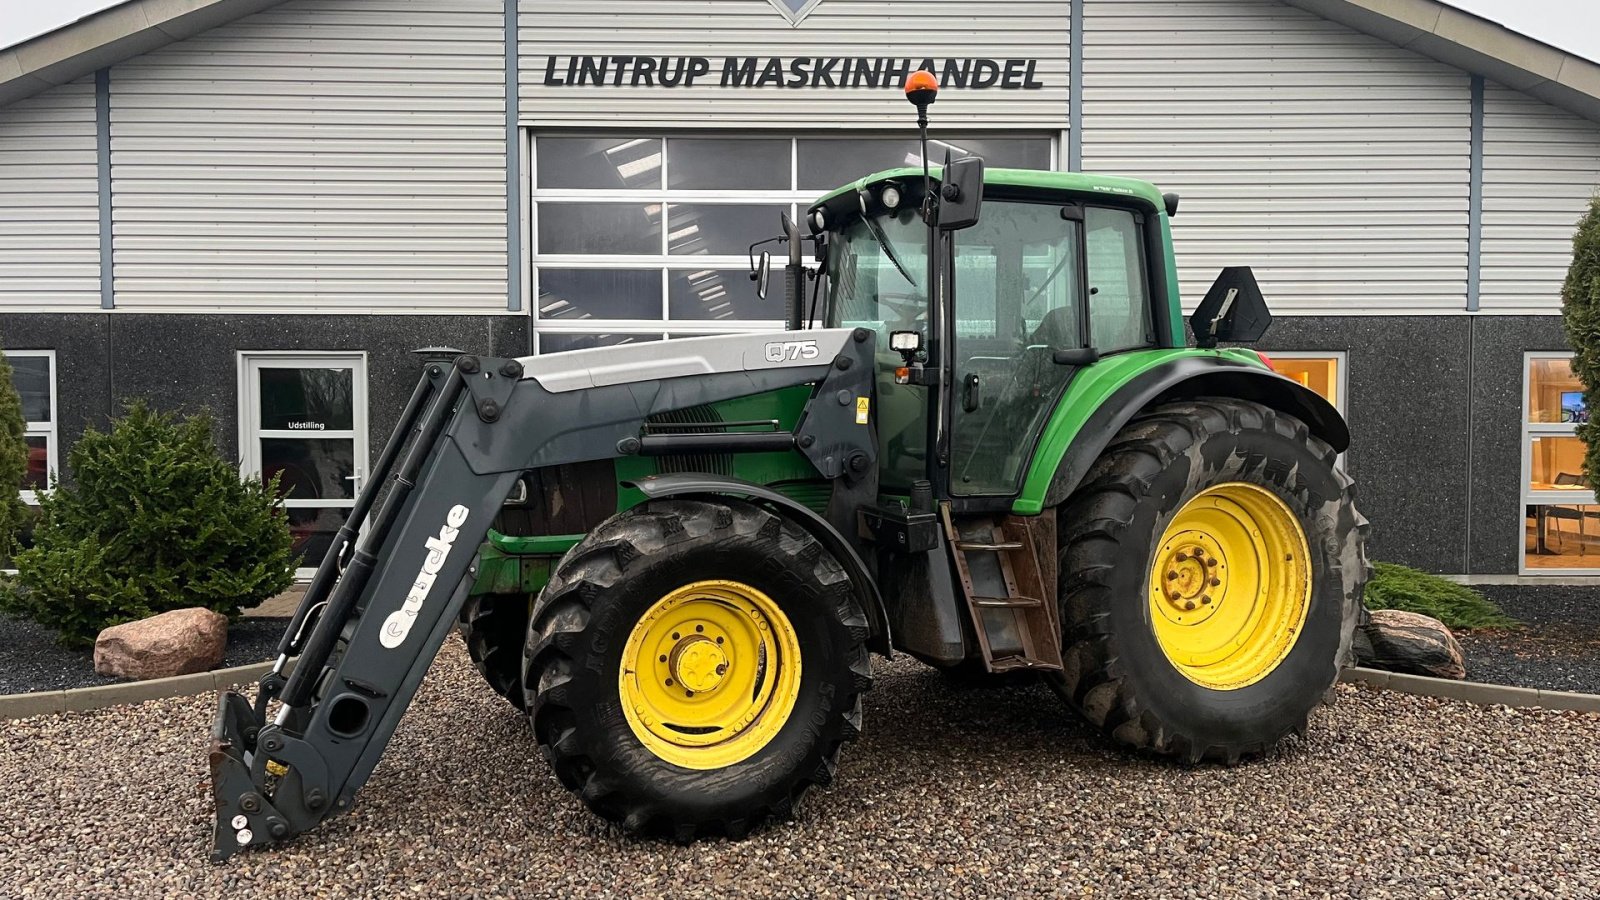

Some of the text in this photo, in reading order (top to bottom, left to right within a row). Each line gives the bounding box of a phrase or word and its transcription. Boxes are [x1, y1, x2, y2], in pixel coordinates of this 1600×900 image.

[544, 56, 710, 88] LINTRUP
[765, 340, 820, 362] Q75
[288, 421, 325, 431] Udstilling
